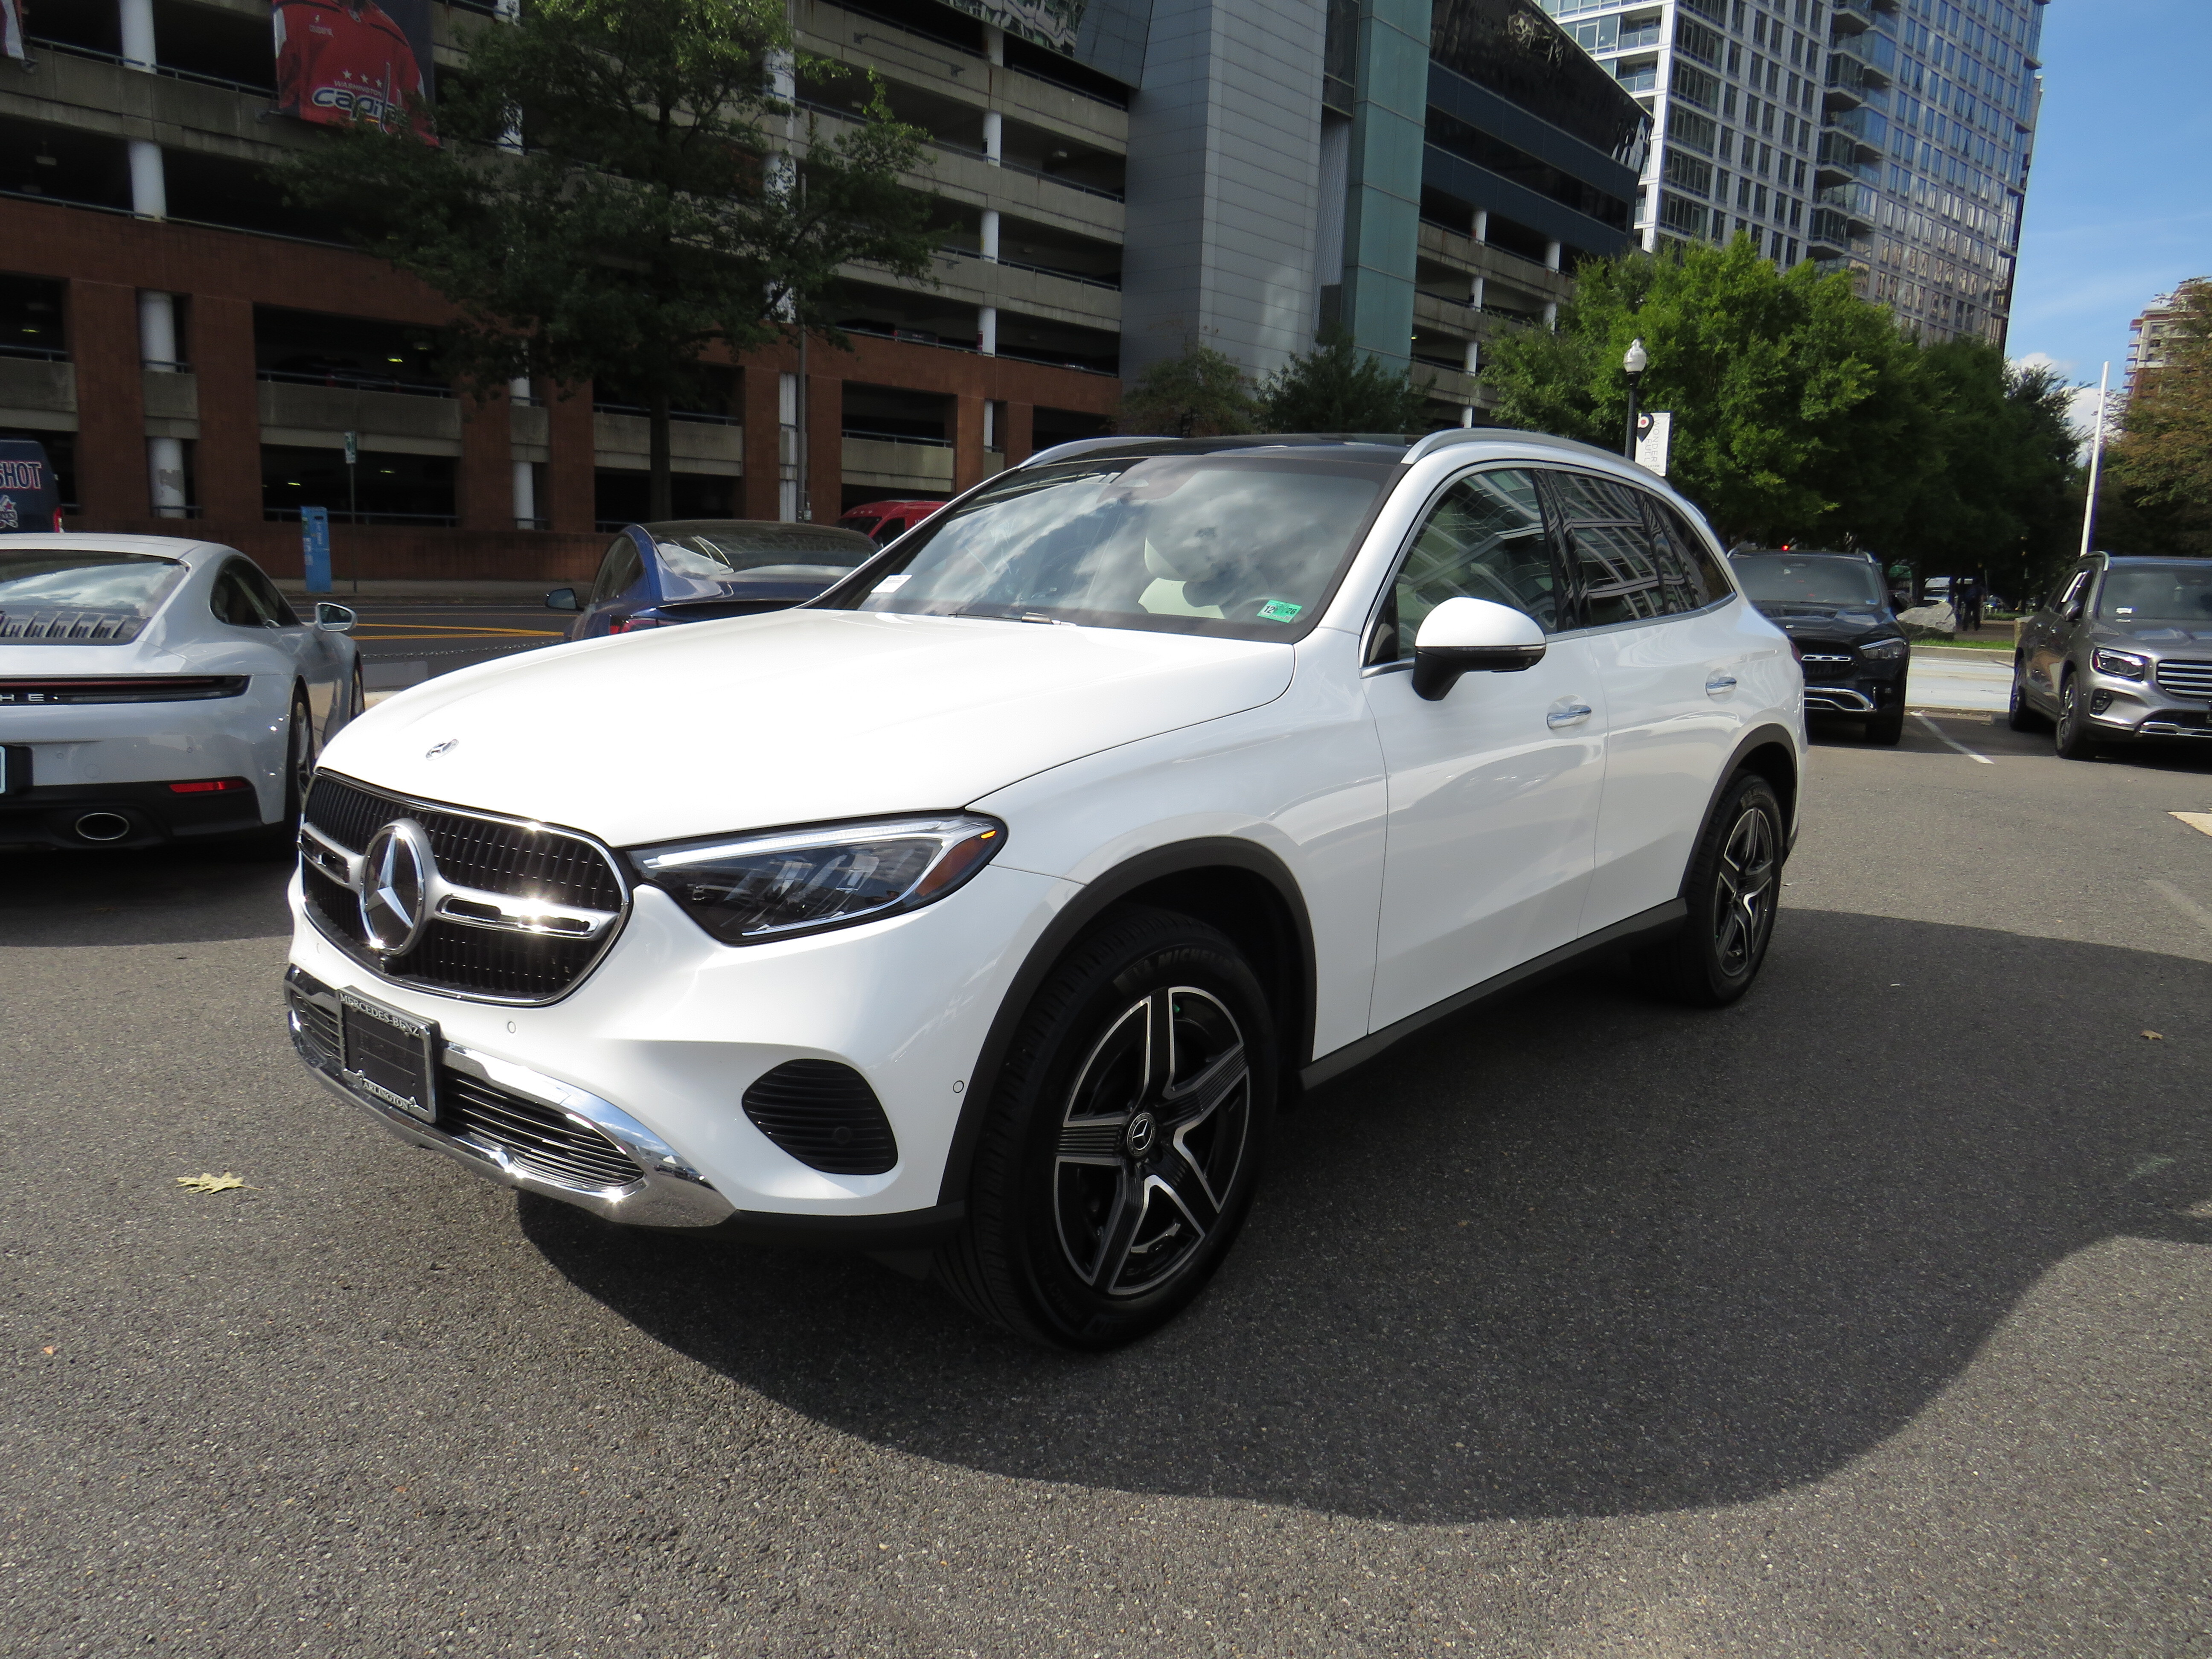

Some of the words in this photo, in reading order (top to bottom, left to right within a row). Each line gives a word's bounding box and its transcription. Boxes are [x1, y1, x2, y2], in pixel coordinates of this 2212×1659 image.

[334, 80, 383, 97] WASHINGTON
[1651, 419, 1660, 462] WONDER
[1264, 605, 1275, 614] 12
[339, 992, 420, 1036] MERCEDES-BENZ
[363, 1082, 409, 1110] ARLINGTON
